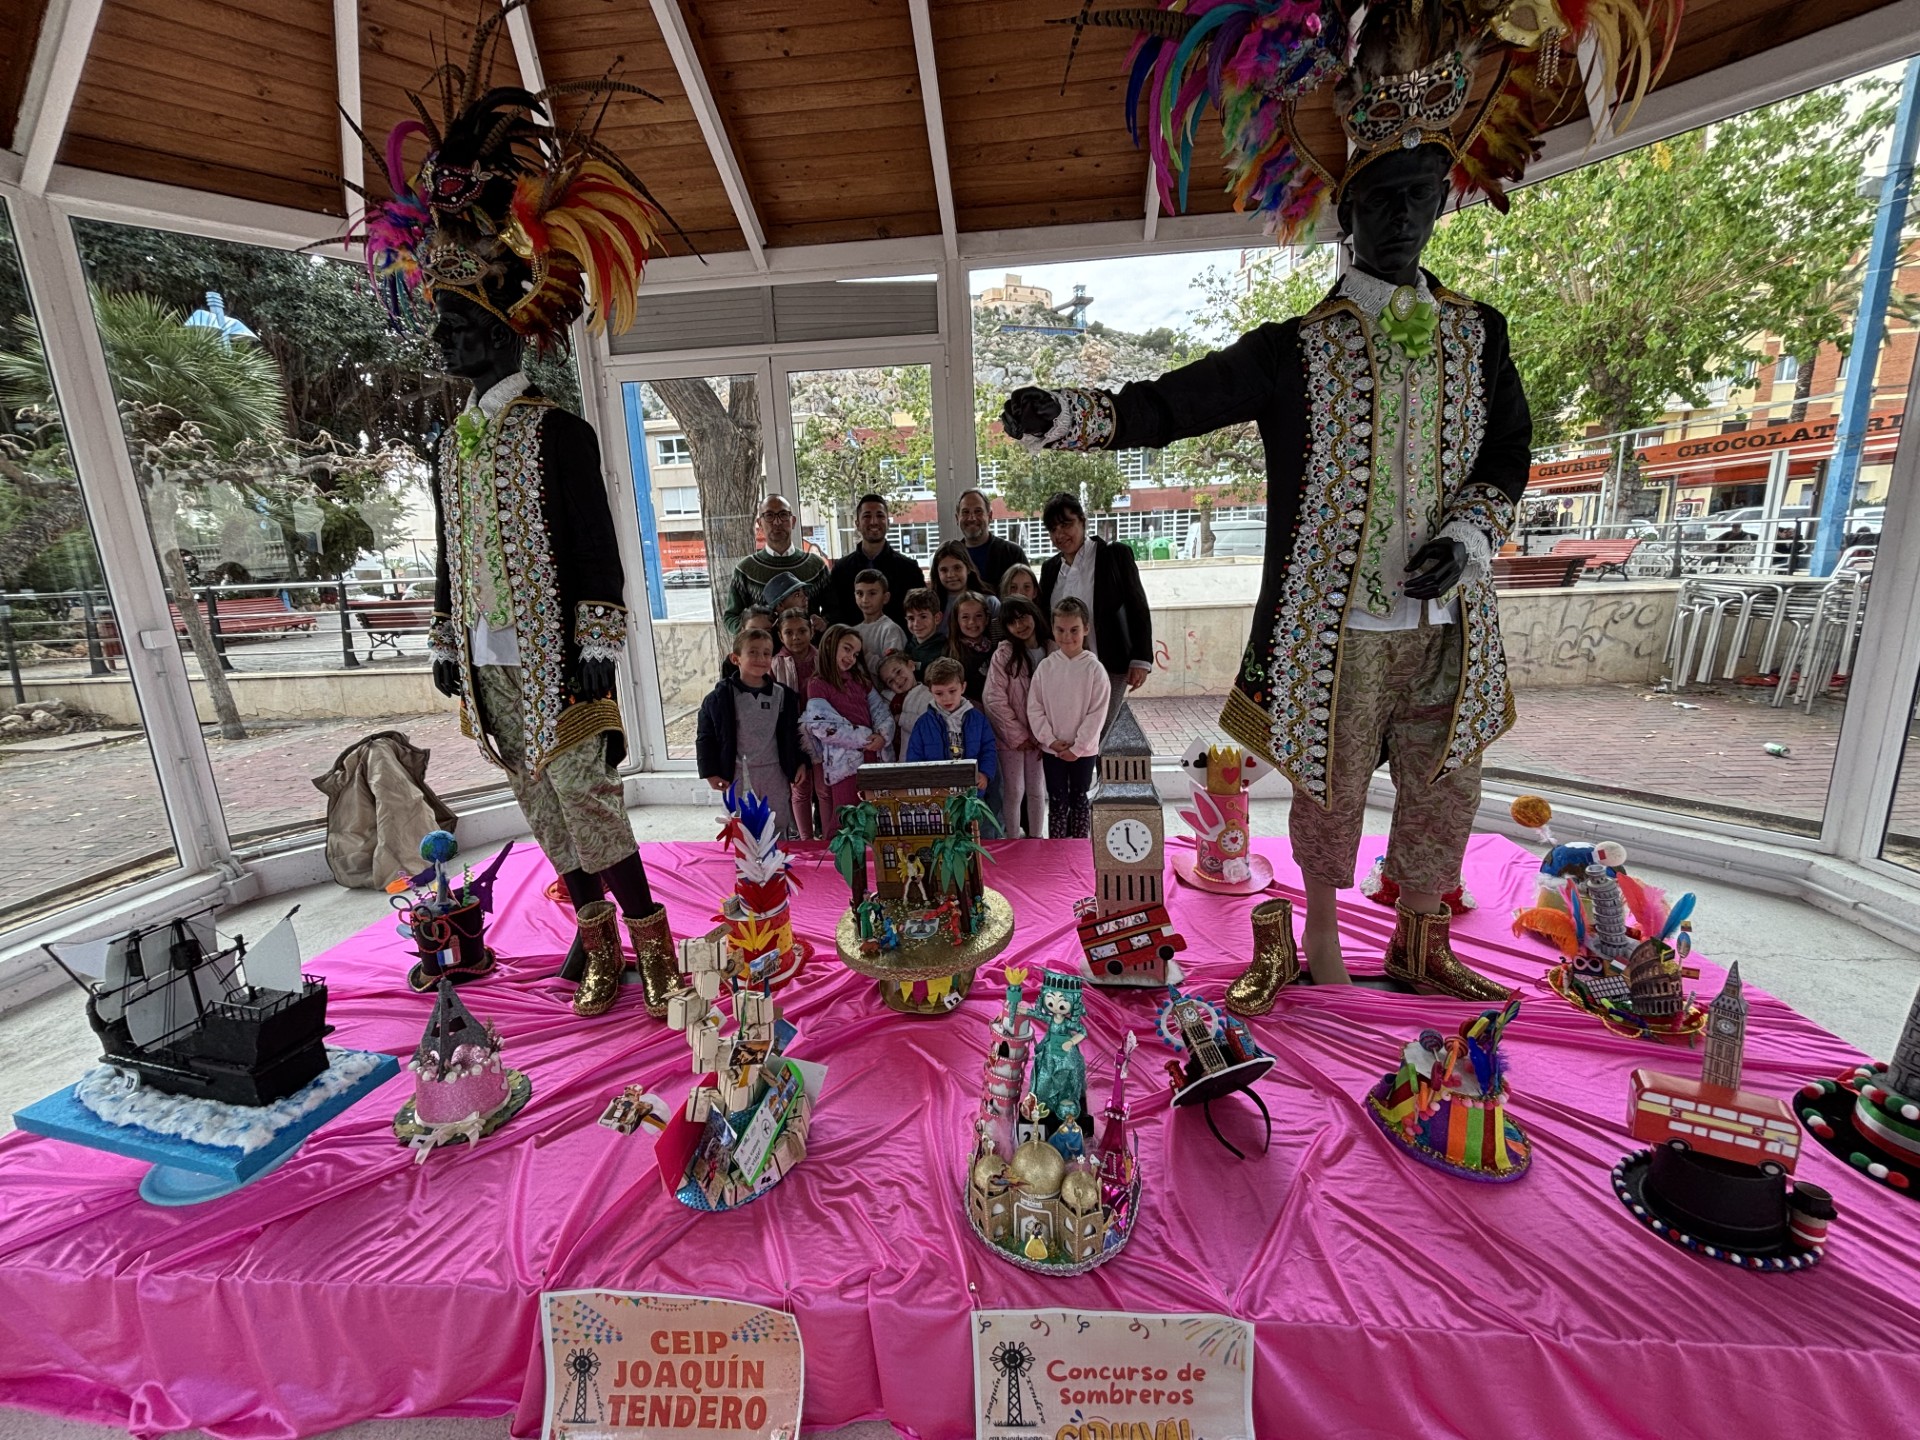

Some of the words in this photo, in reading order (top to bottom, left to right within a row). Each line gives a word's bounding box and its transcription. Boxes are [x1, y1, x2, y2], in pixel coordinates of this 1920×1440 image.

[1538, 451, 1650, 477] CHURREA
[1677, 413, 1905, 458] CHOCOLATRI
[650, 1330, 728, 1355] CEIP
[613, 1354, 765, 1394] JOAQUÍN
[1046, 1359, 1168, 1382] Concurso
[1177, 1362, 1206, 1382] de
[1059, 1381, 1194, 1405] sombreros
[607, 1394, 767, 1431] TENDERO
